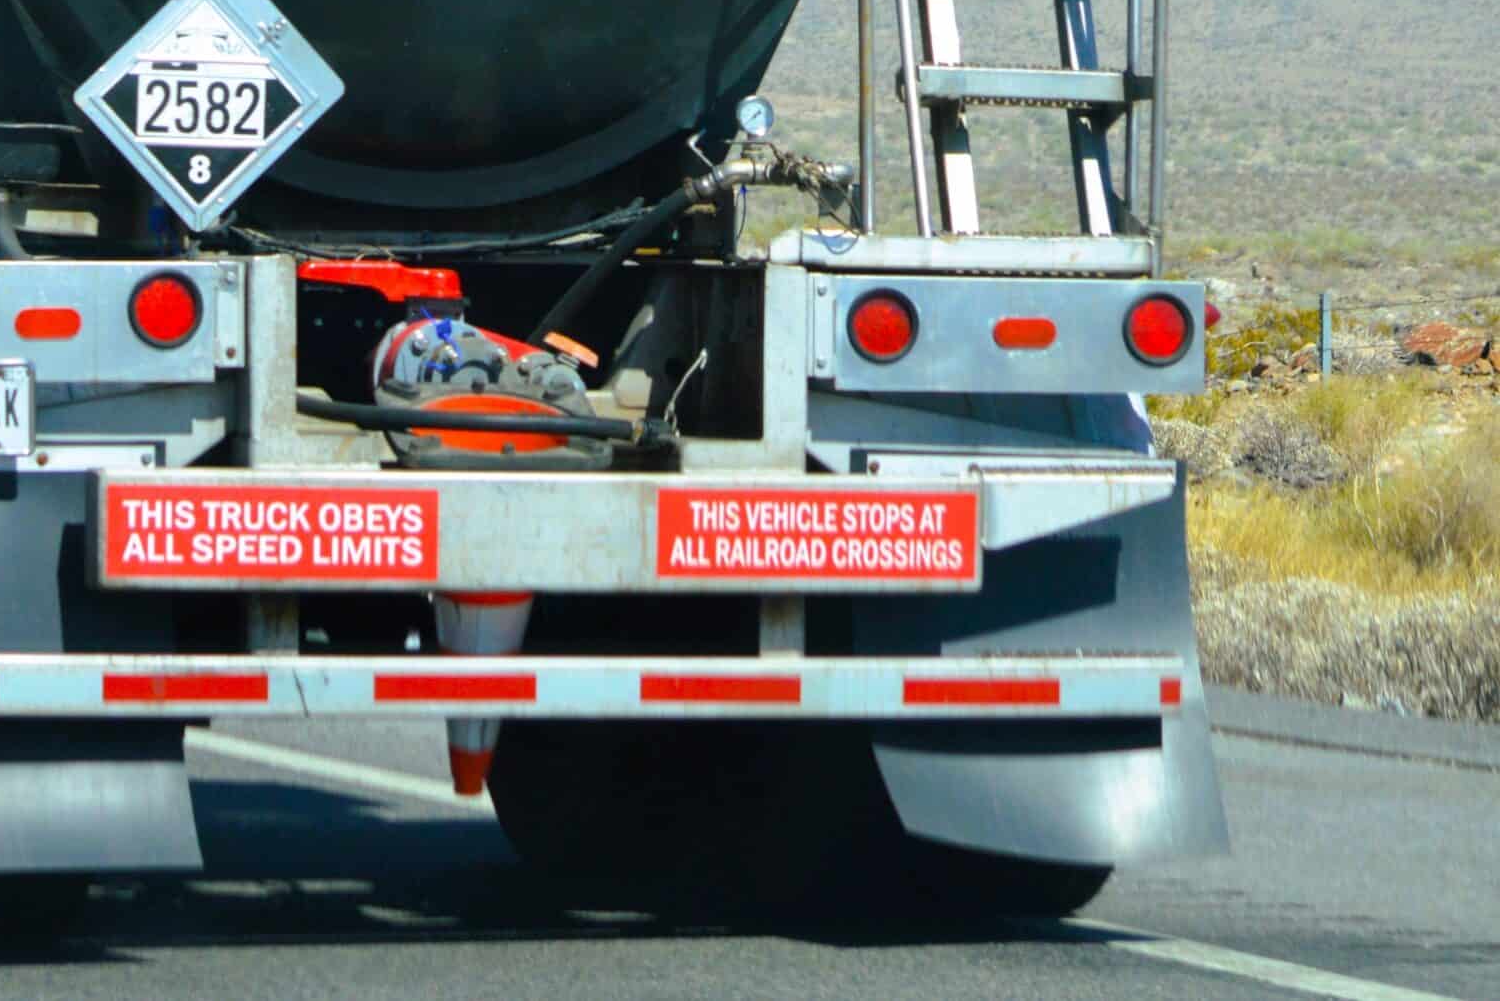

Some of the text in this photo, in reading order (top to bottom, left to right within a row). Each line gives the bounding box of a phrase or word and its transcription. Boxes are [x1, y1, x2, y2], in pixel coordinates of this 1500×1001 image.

[143, 79, 260, 136] 2582
[187, 154, 212, 184] 8
[122, 499, 424, 533] THIS TRUCK OBEYS
[689, 500, 946, 534] THIS VEHICLE STOPS AT
[122, 532, 424, 566] ALL SPEED LIMITS
[670, 536, 963, 570] ALL RAILROAD CROSSINGS
